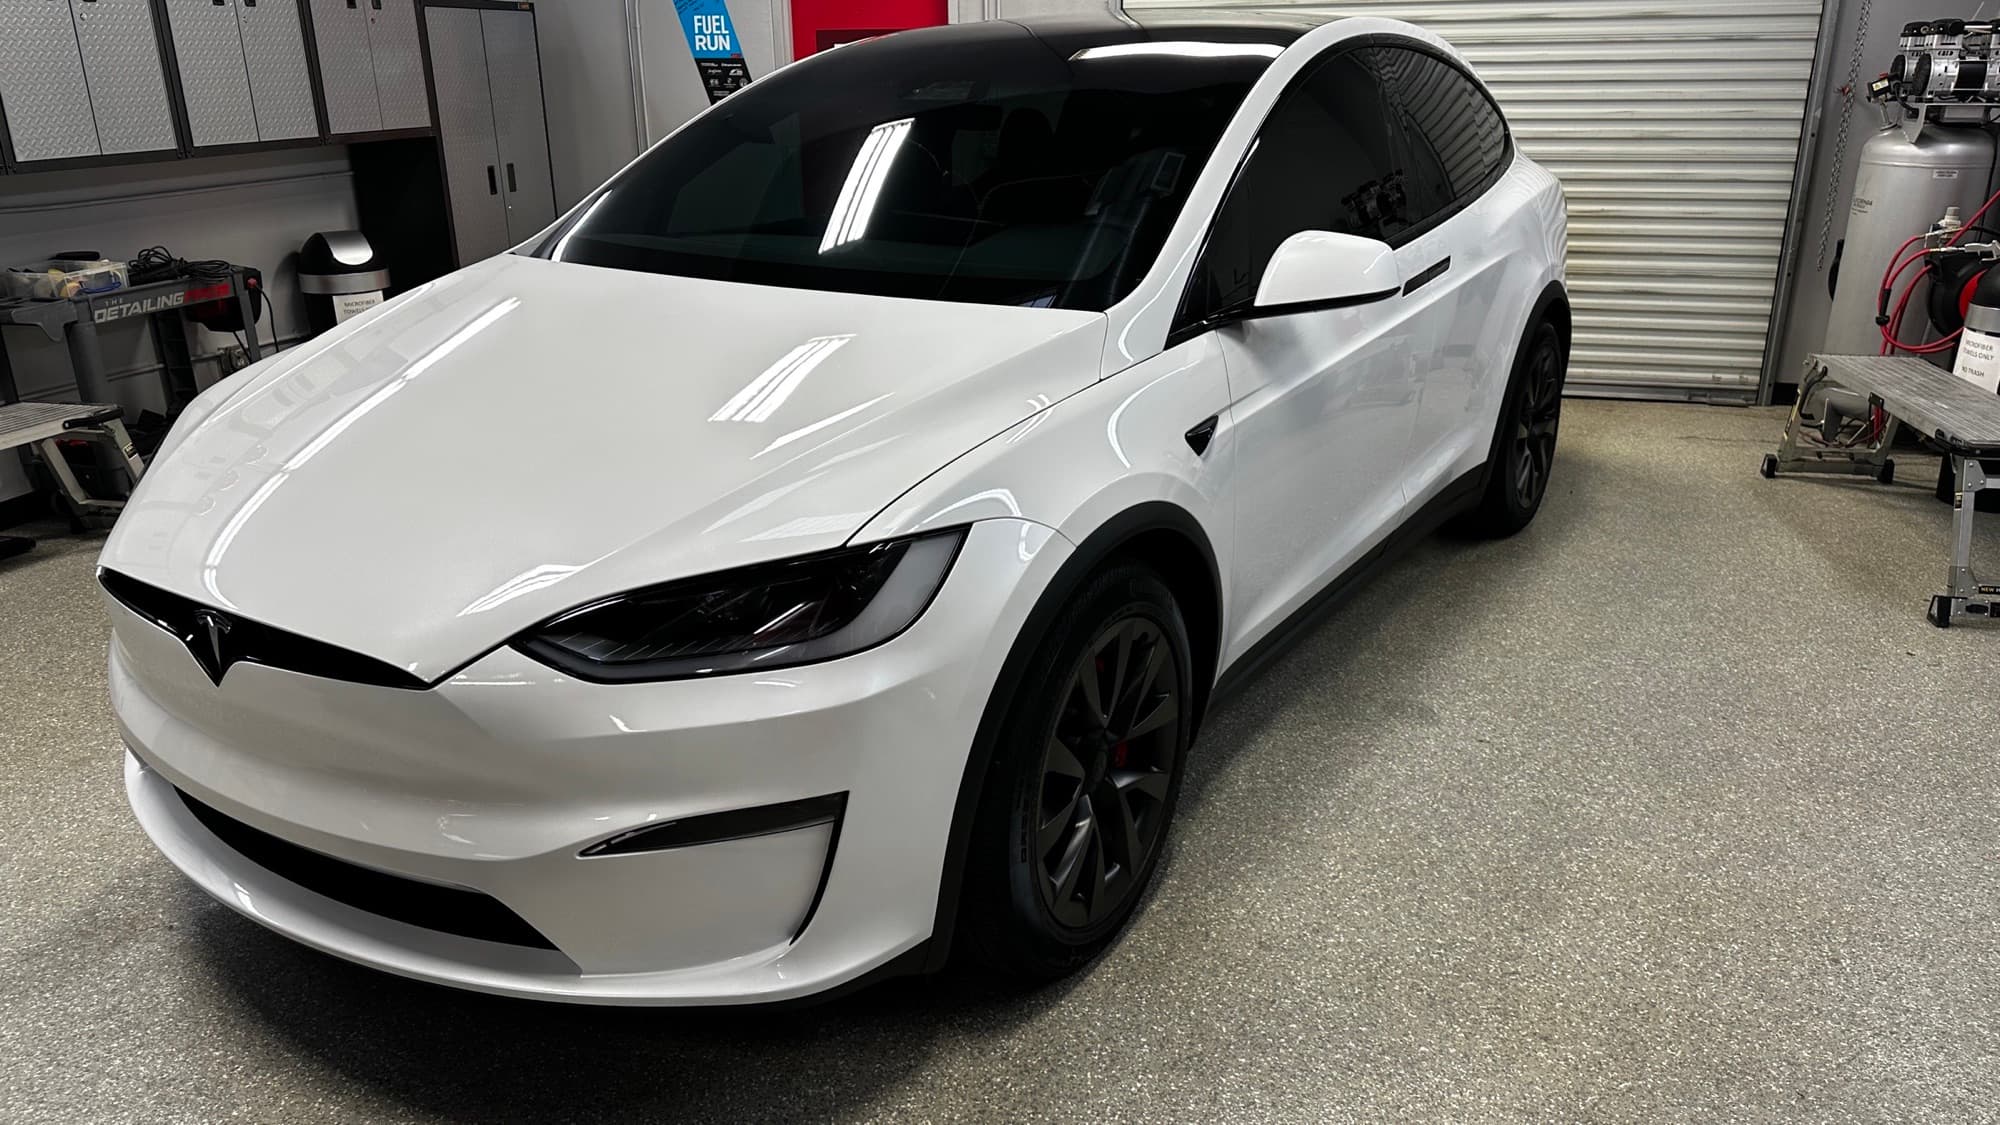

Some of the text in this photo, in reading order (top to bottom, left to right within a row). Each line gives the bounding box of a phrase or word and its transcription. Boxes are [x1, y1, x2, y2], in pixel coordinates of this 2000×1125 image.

[694, 15, 729, 34] FUEL
[695, 35, 730, 50] RUN
[94, 291, 185, 324] DETAILING
[105, 297, 124, 307] THE
[1978, 352, 1994, 361] ONLY
[1968, 367, 1985, 377] TRASH
